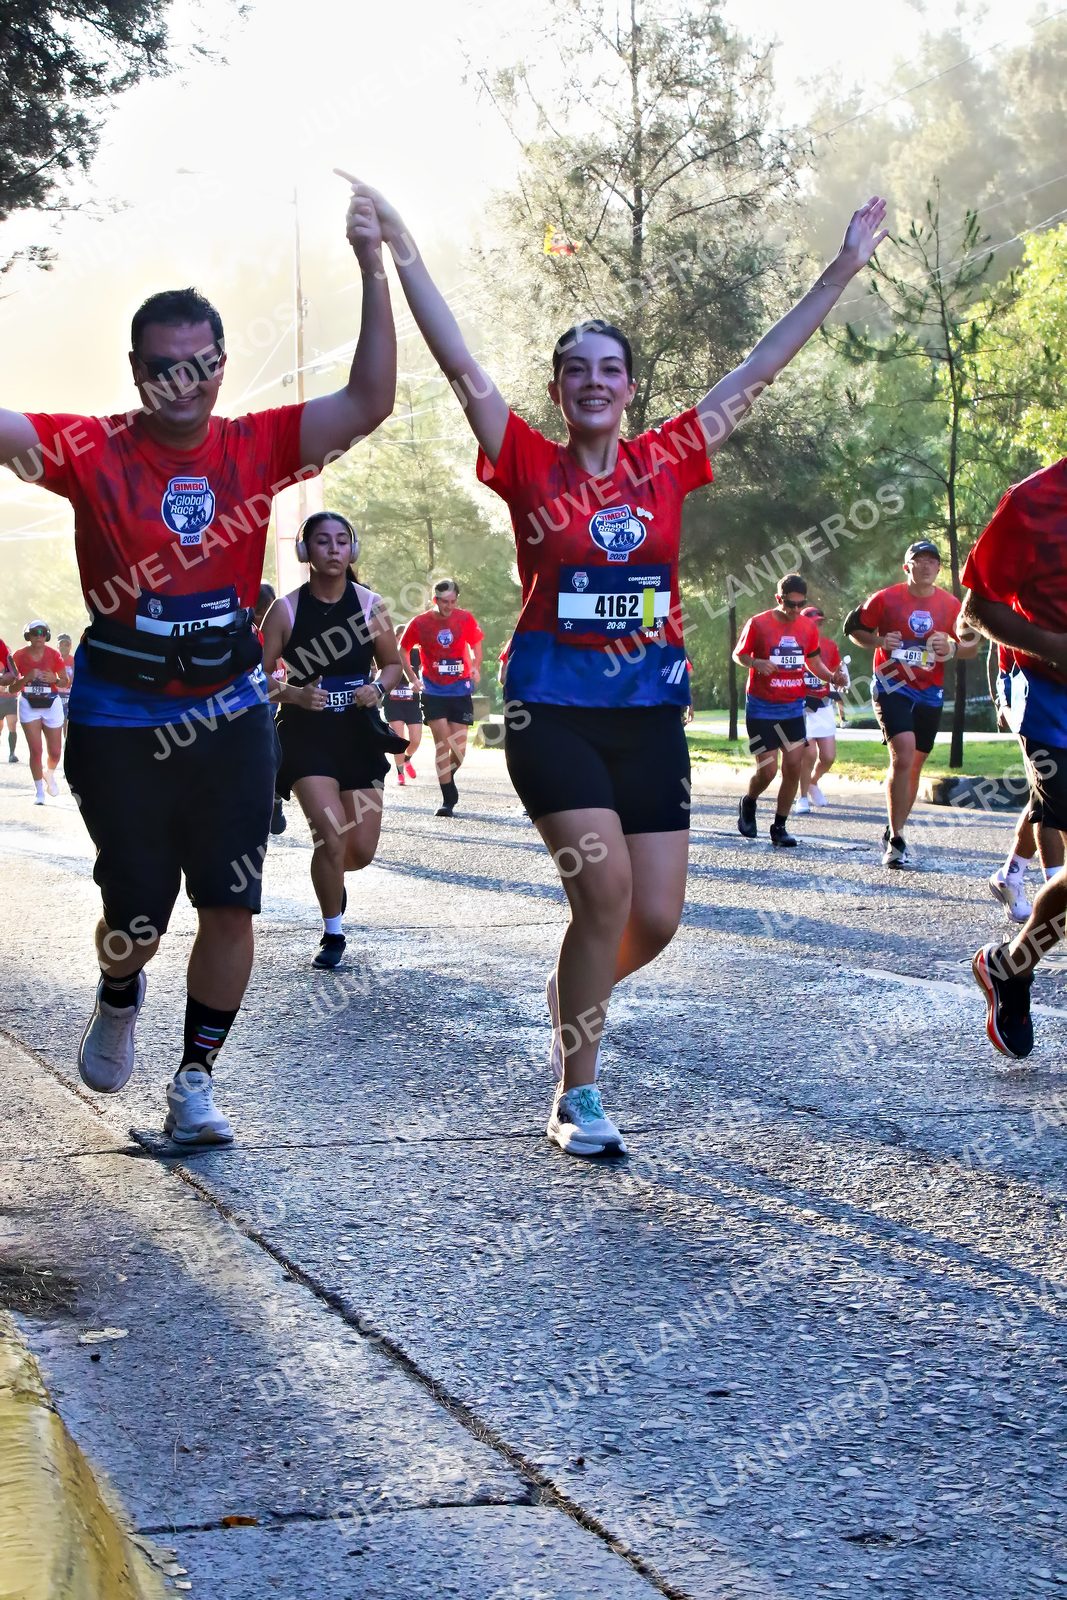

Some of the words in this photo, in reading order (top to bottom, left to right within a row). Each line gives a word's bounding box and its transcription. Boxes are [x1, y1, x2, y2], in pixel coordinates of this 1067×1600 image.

[173, 483, 205, 491] BIMBO
[175, 494, 205, 506] Global
[171, 504, 195, 515] Race
[181, 534, 200, 544] 2026
[594, 594, 639, 618] 4162
[644, 630, 660, 638] 10K
[780, 656, 797, 664] 4540
